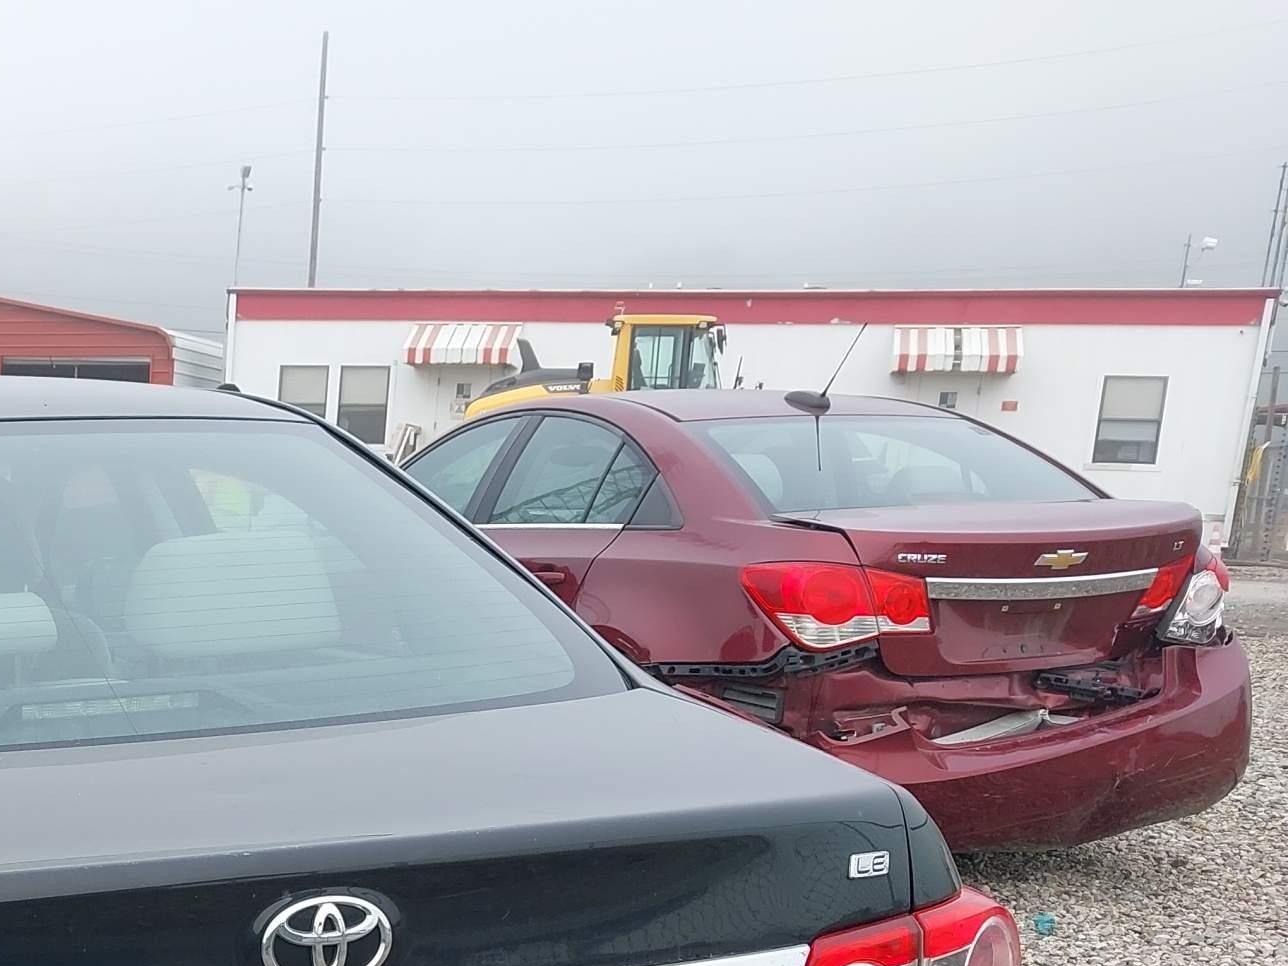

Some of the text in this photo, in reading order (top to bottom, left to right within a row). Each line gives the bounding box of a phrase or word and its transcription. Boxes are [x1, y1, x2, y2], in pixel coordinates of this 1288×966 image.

[1173, 540, 1185, 551] LT
[897, 553, 948, 564] CRUZE
[855, 853, 887, 875] LE
